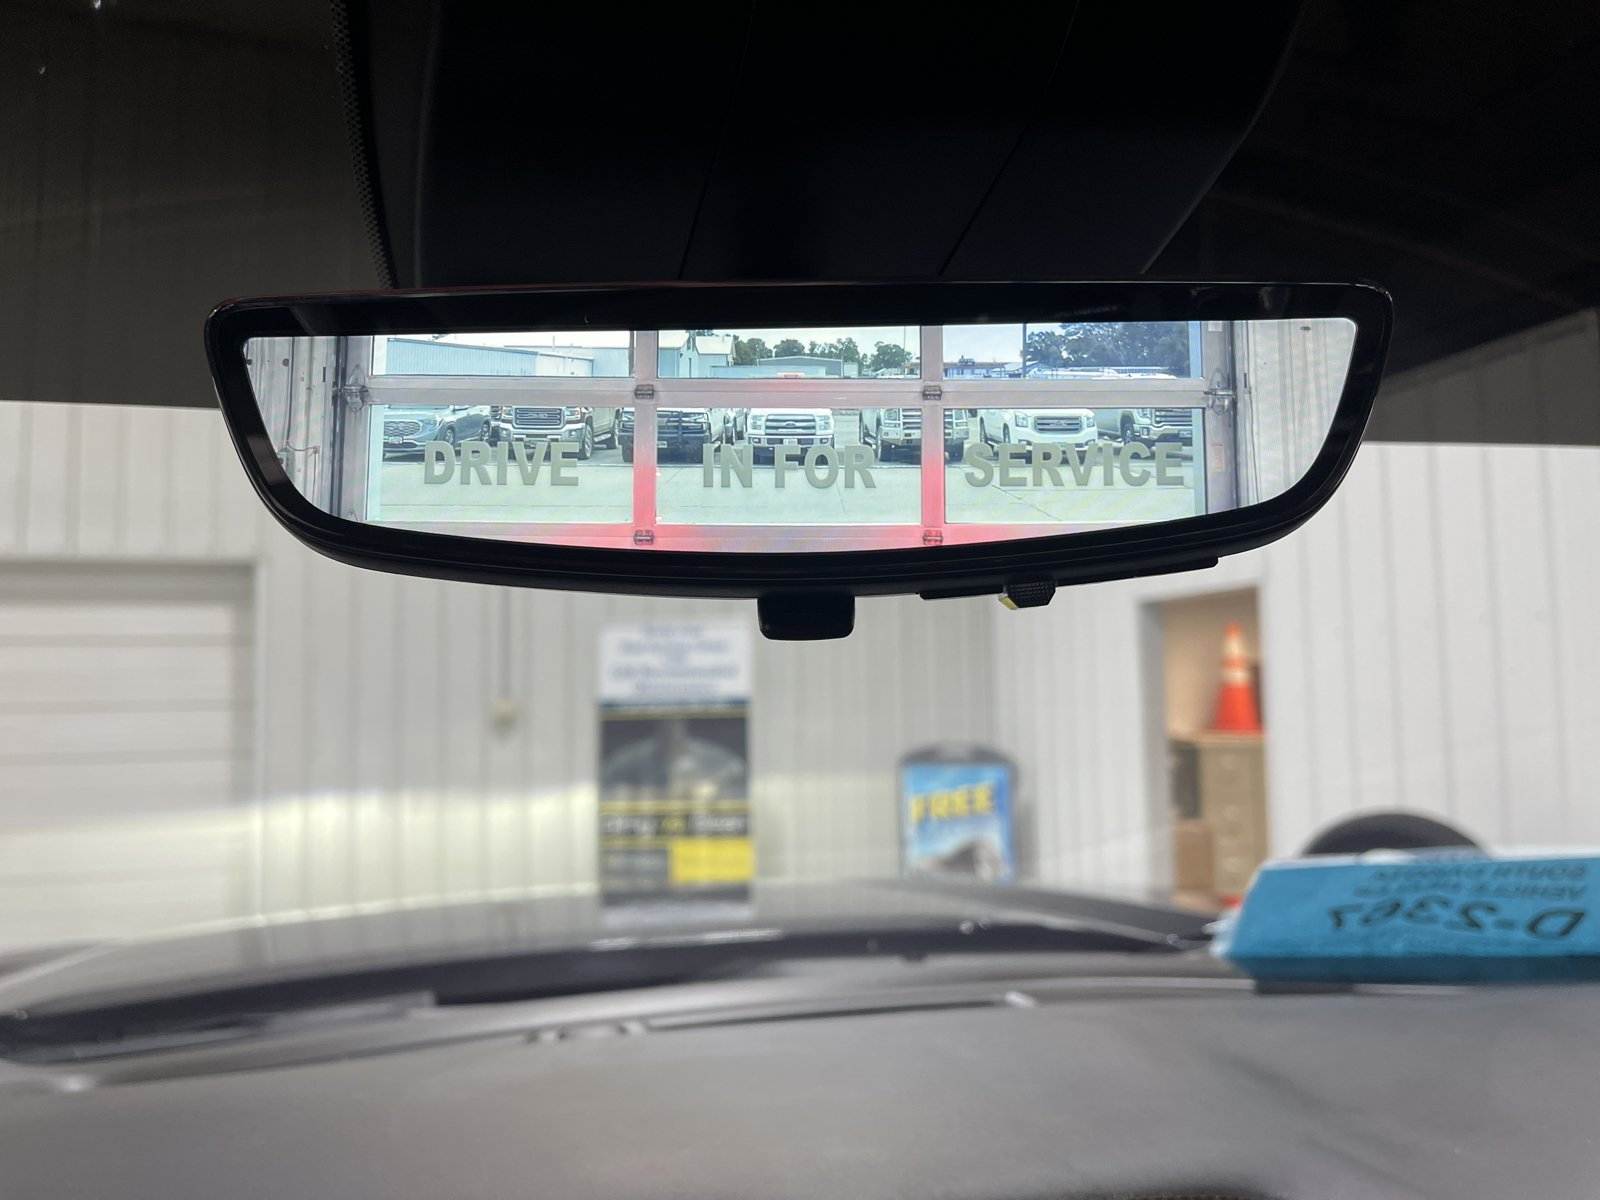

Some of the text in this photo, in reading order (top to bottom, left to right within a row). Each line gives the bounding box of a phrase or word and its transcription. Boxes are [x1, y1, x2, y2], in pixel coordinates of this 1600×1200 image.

[424, 440, 1184, 489] DRIVE IN FOR SERVICE
[908, 785, 993, 824] FREE
